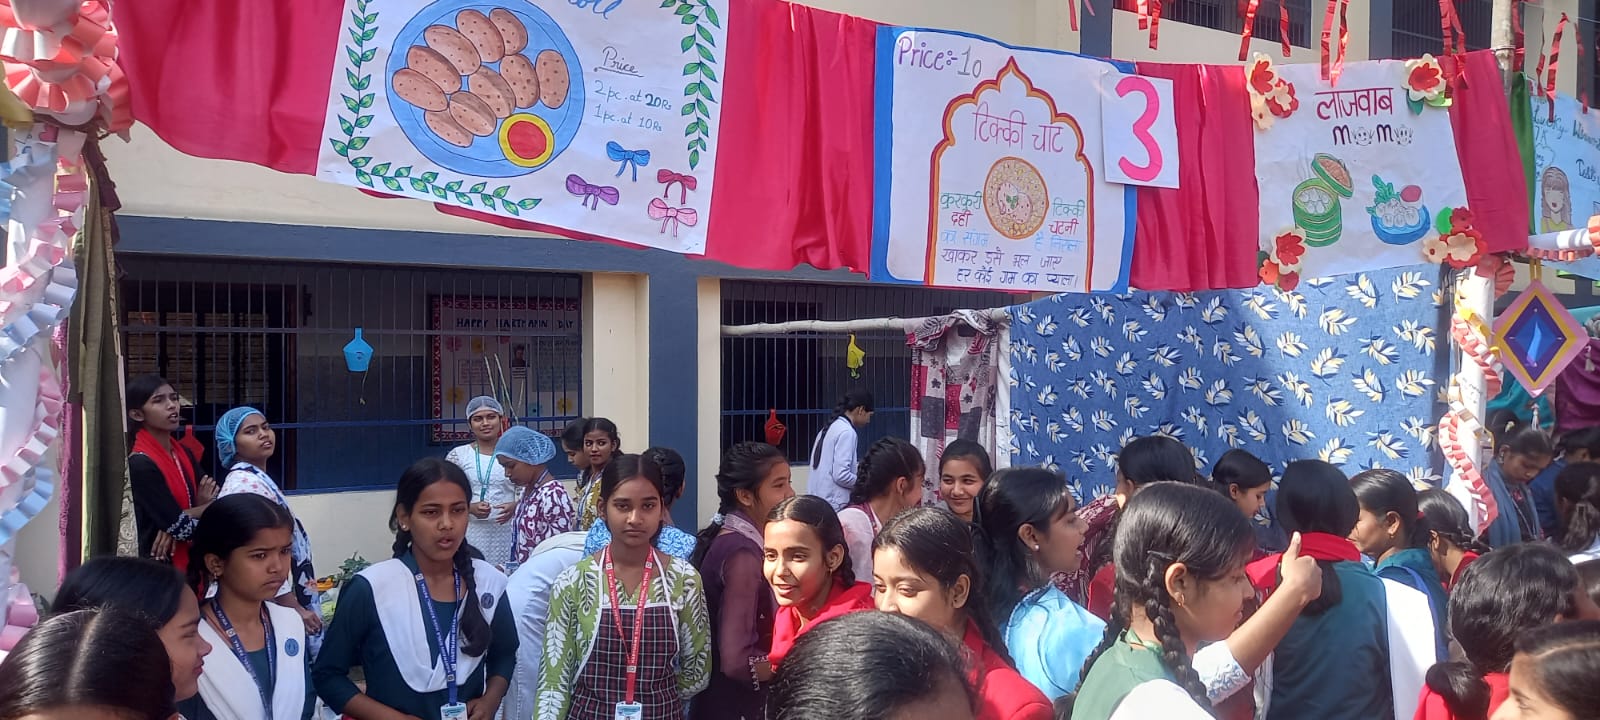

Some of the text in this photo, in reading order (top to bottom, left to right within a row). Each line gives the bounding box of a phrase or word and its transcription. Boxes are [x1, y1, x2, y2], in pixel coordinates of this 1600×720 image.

[602, 46, 639, 74] Price
[1314, 87, 1394, 120] लाजवाब
[972, 101, 1064, 153] टिक्की चाट
[1115, 76, 1163, 182] 3
[951, 209, 1079, 235] दही चटनी
